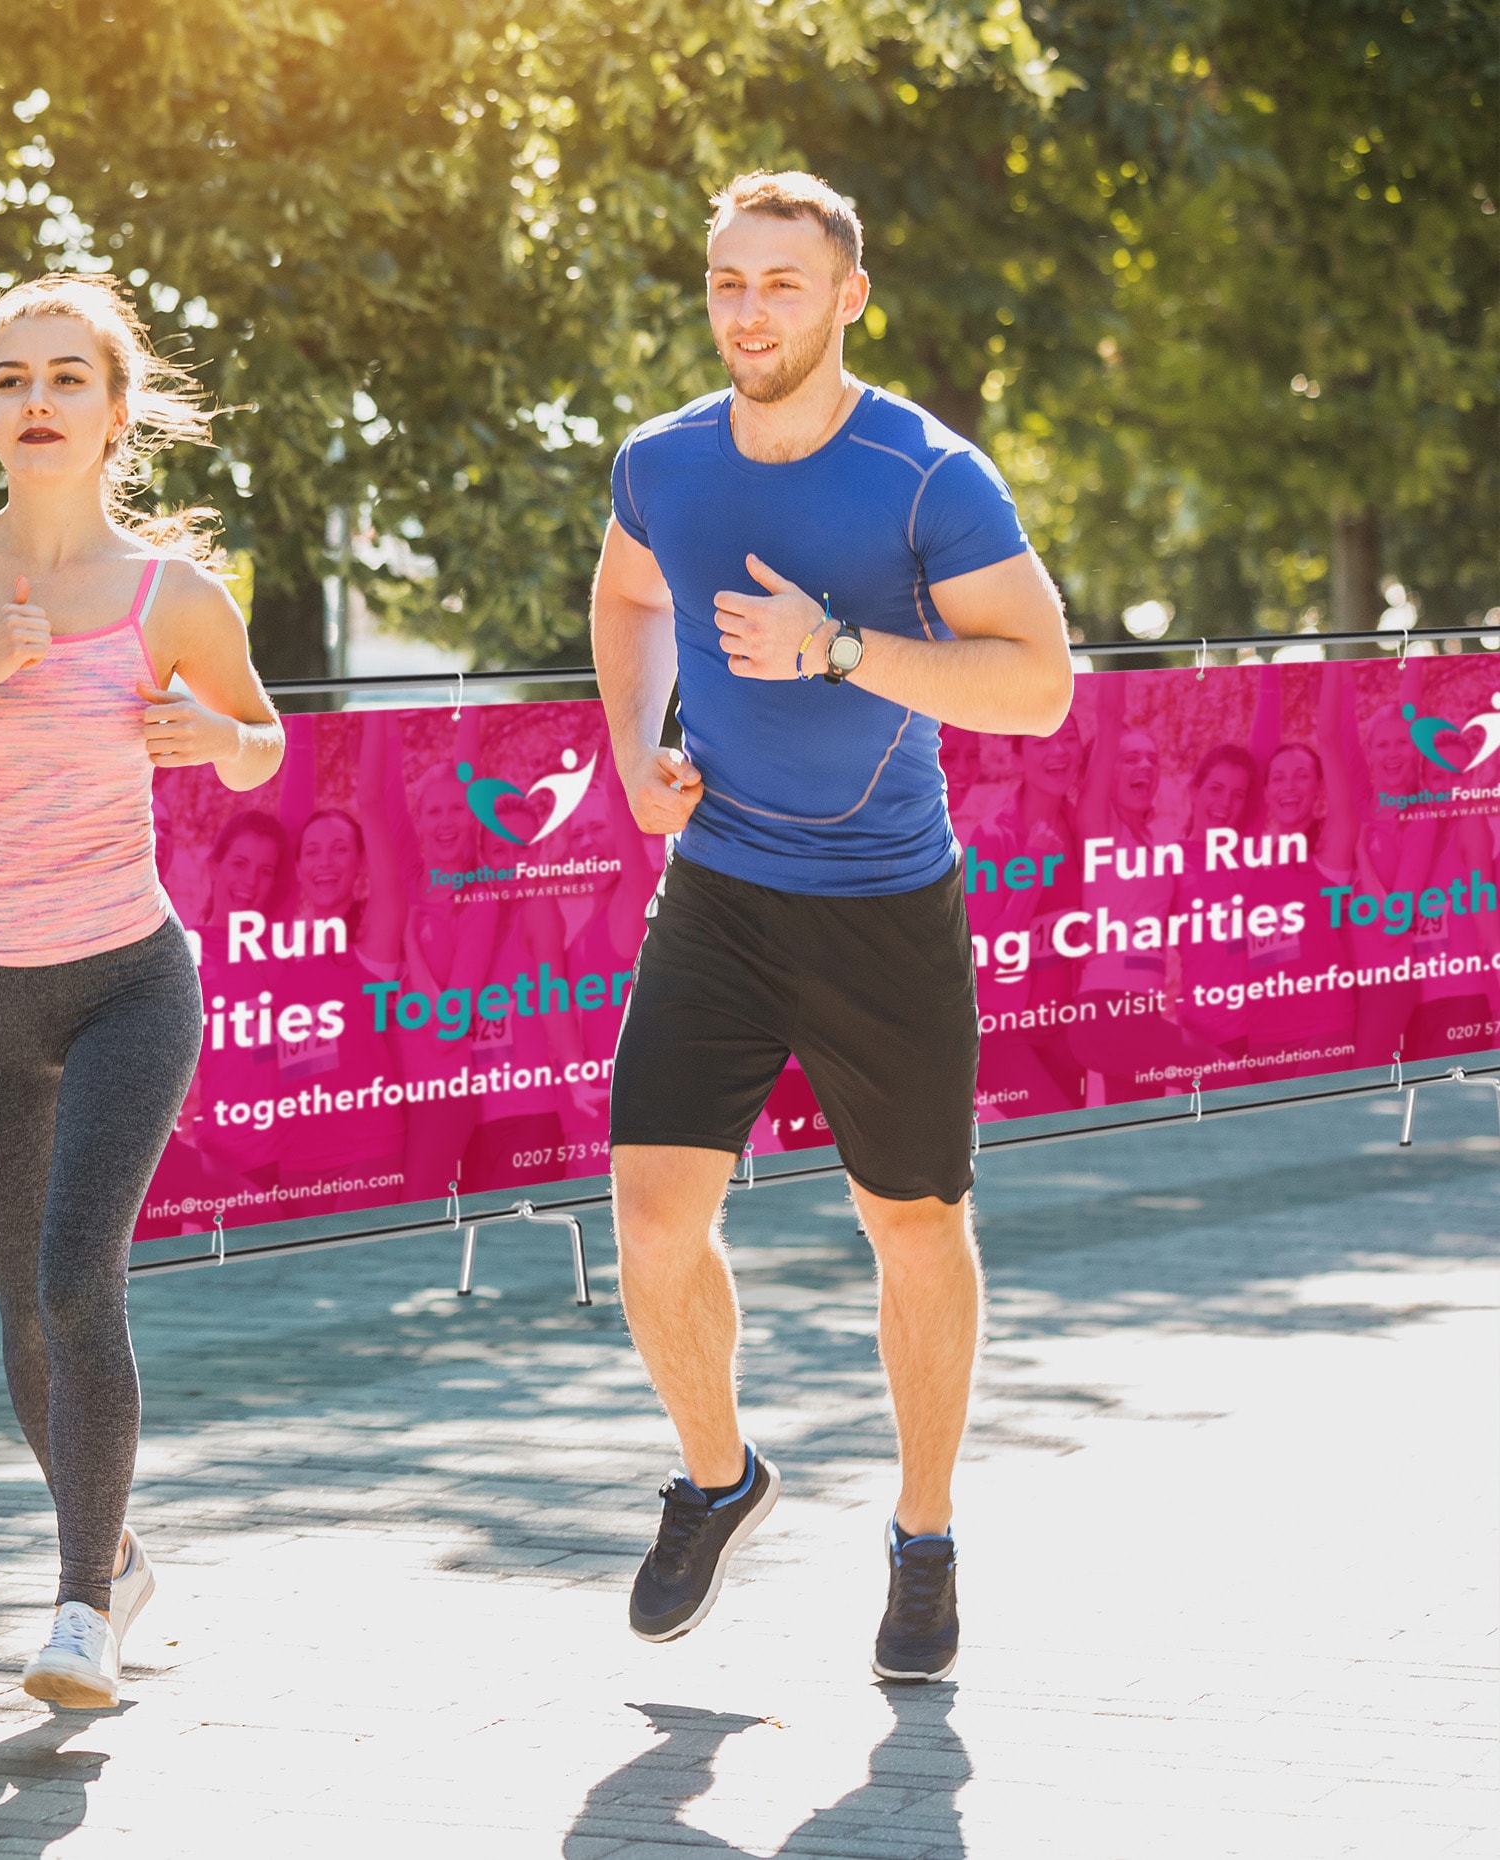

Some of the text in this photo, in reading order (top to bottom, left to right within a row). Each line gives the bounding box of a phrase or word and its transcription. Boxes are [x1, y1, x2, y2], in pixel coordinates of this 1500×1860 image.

[1377, 782, 1500, 811] TogetherFound
[1398, 804, 1500, 822] RAISING AWAREN
[428, 854, 623, 891] TogetherFoundation
[1083, 836, 1184, 883] Fun
[1205, 827, 1308, 872] Run
[452, 882, 596, 905] RAISING AWARENESS
[1052, 894, 1305, 958] Charities
[1320, 869, 1497, 935] Togeth
[228, 910, 347, 964] Run
[201, 990, 345, 1050] ities
[361, 962, 633, 1041] Together
[978, 999, 1097, 1035] onation
[1107, 988, 1166, 1017] visit
[1192, 952, 1500, 1010] togetherfoundation.c
[1447, 1021, 1500, 1040] 0207 57
[1134, 1043, 1356, 1085] info@togetherfoundation.com
[513, 1140, 610, 1168] 0207 573 94
[145, 1172, 405, 1221] info@togetherfoundation.com
